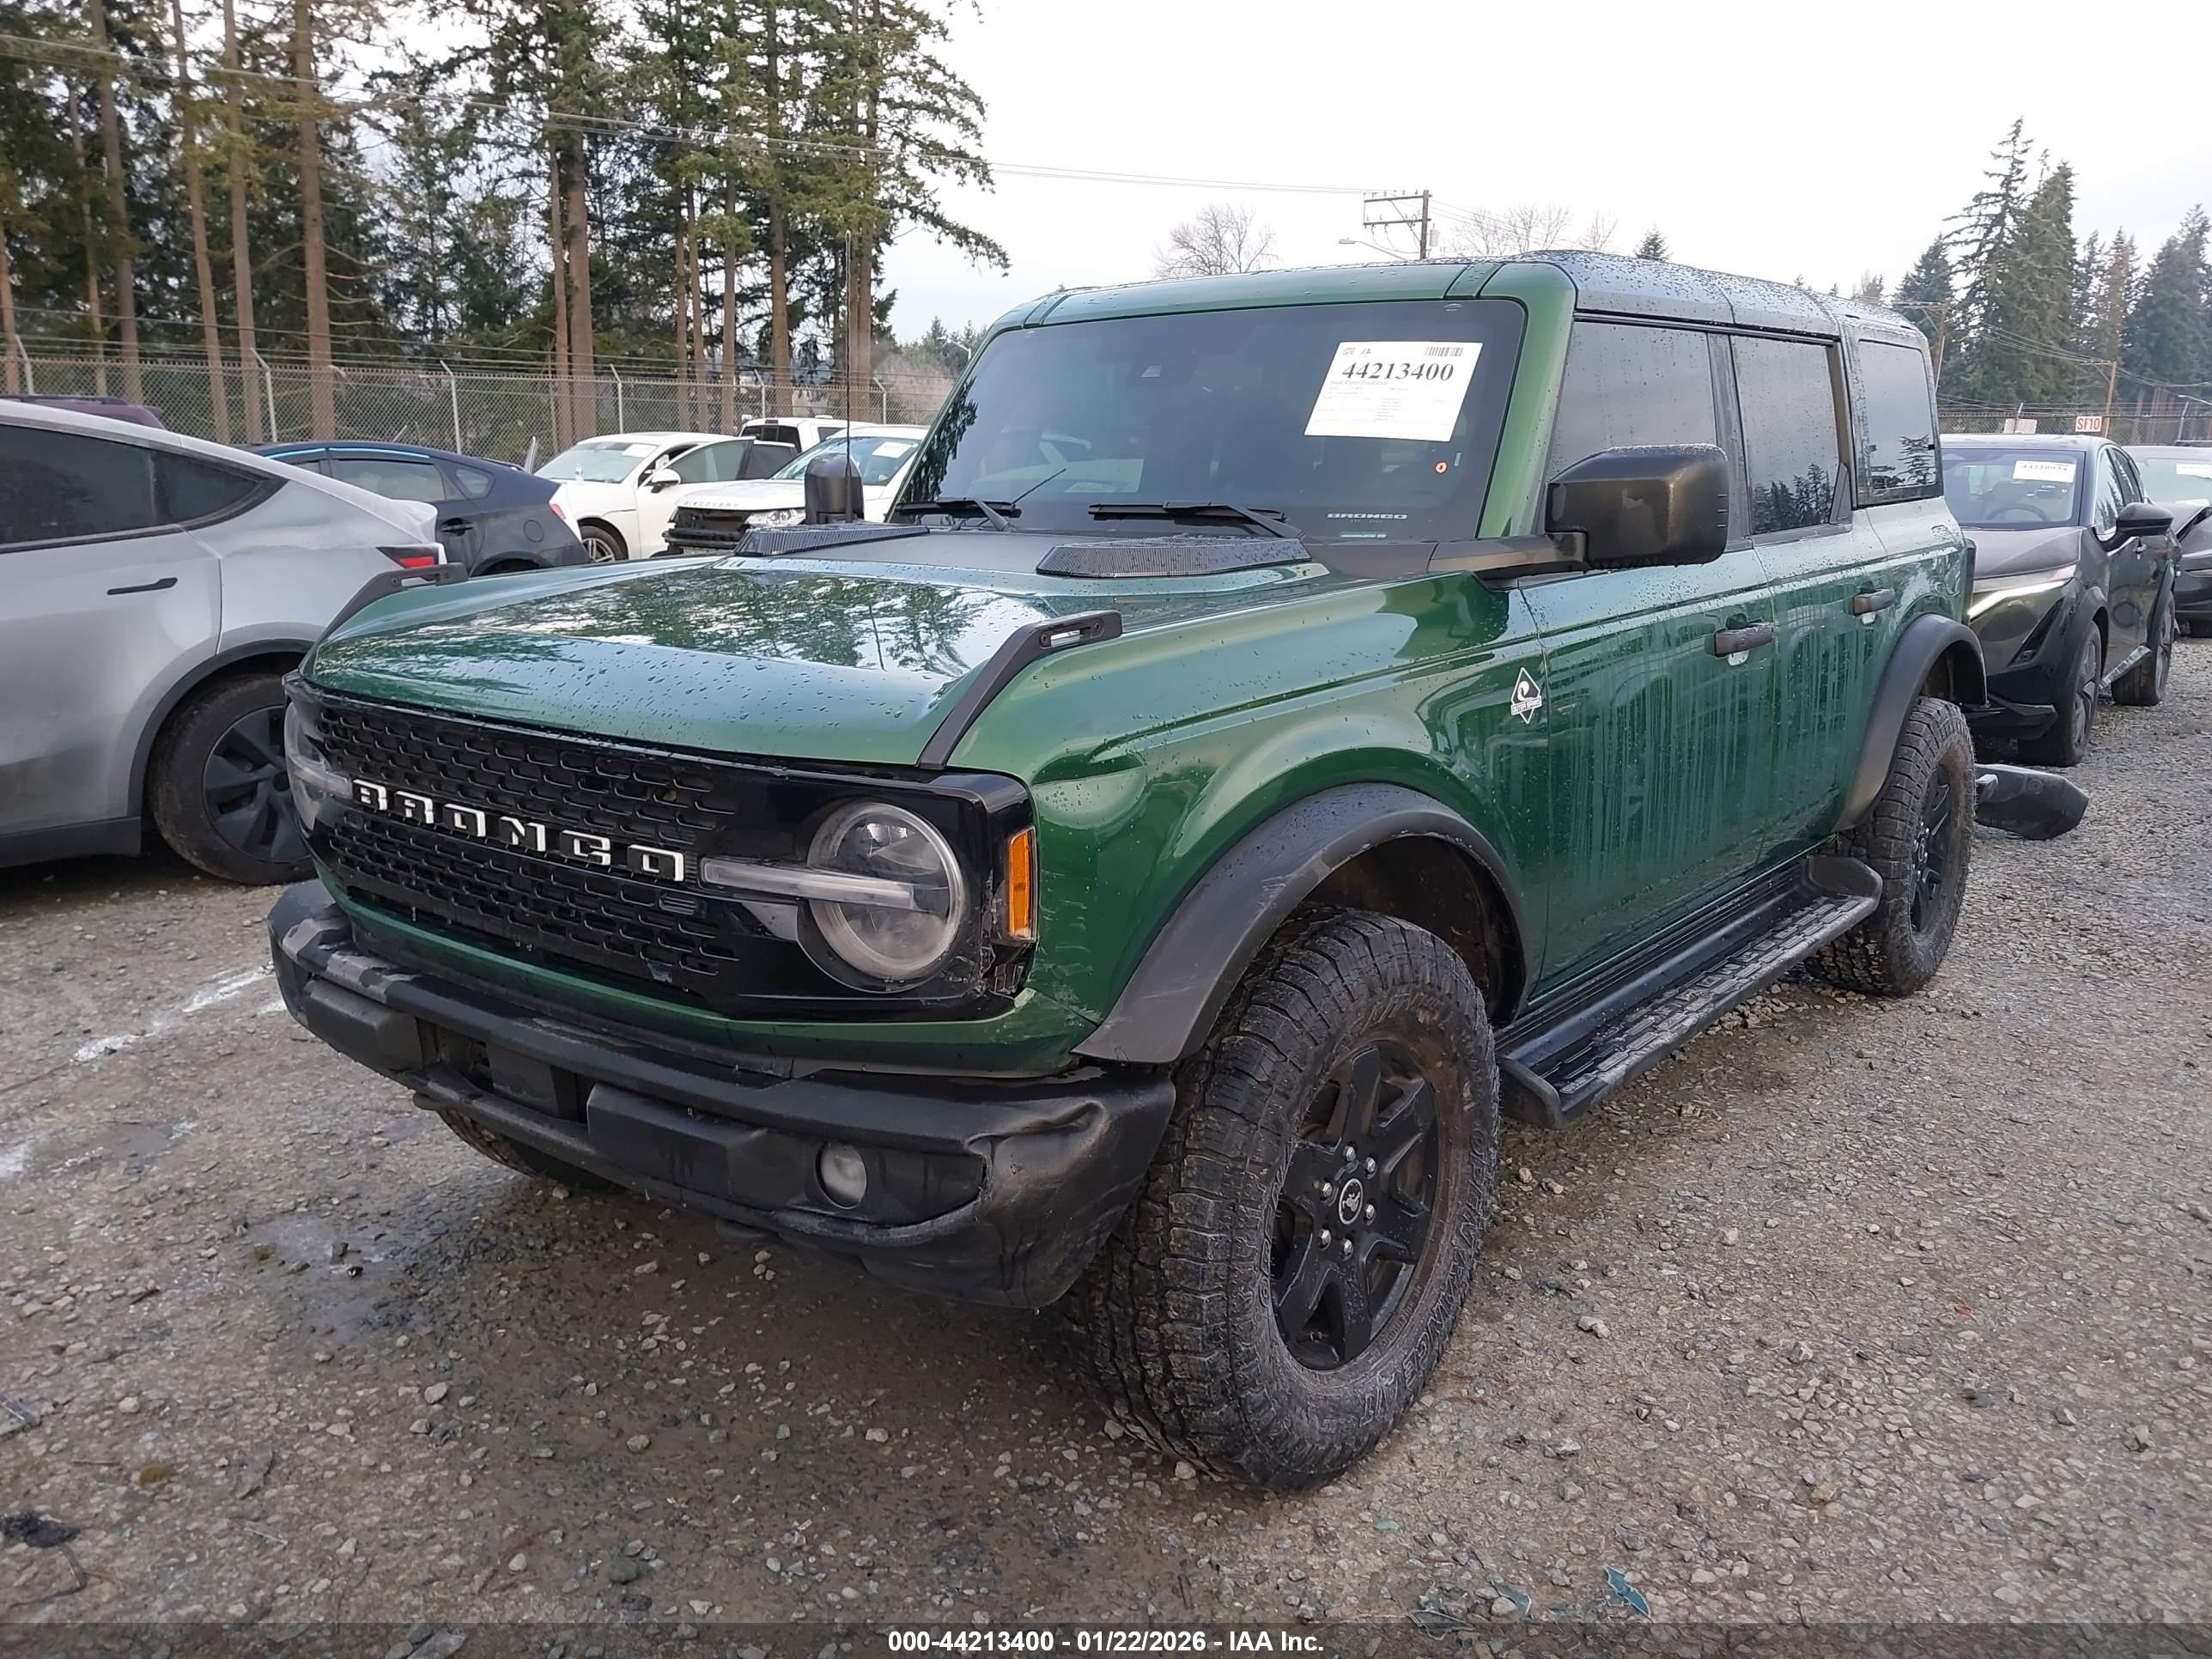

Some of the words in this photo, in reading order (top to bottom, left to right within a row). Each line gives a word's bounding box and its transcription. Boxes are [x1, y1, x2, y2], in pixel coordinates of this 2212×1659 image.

[1342, 362, 1454, 380] 44213400
[2077, 417, 2100, 430] SF10
[352, 778, 685, 882] BRONCO
